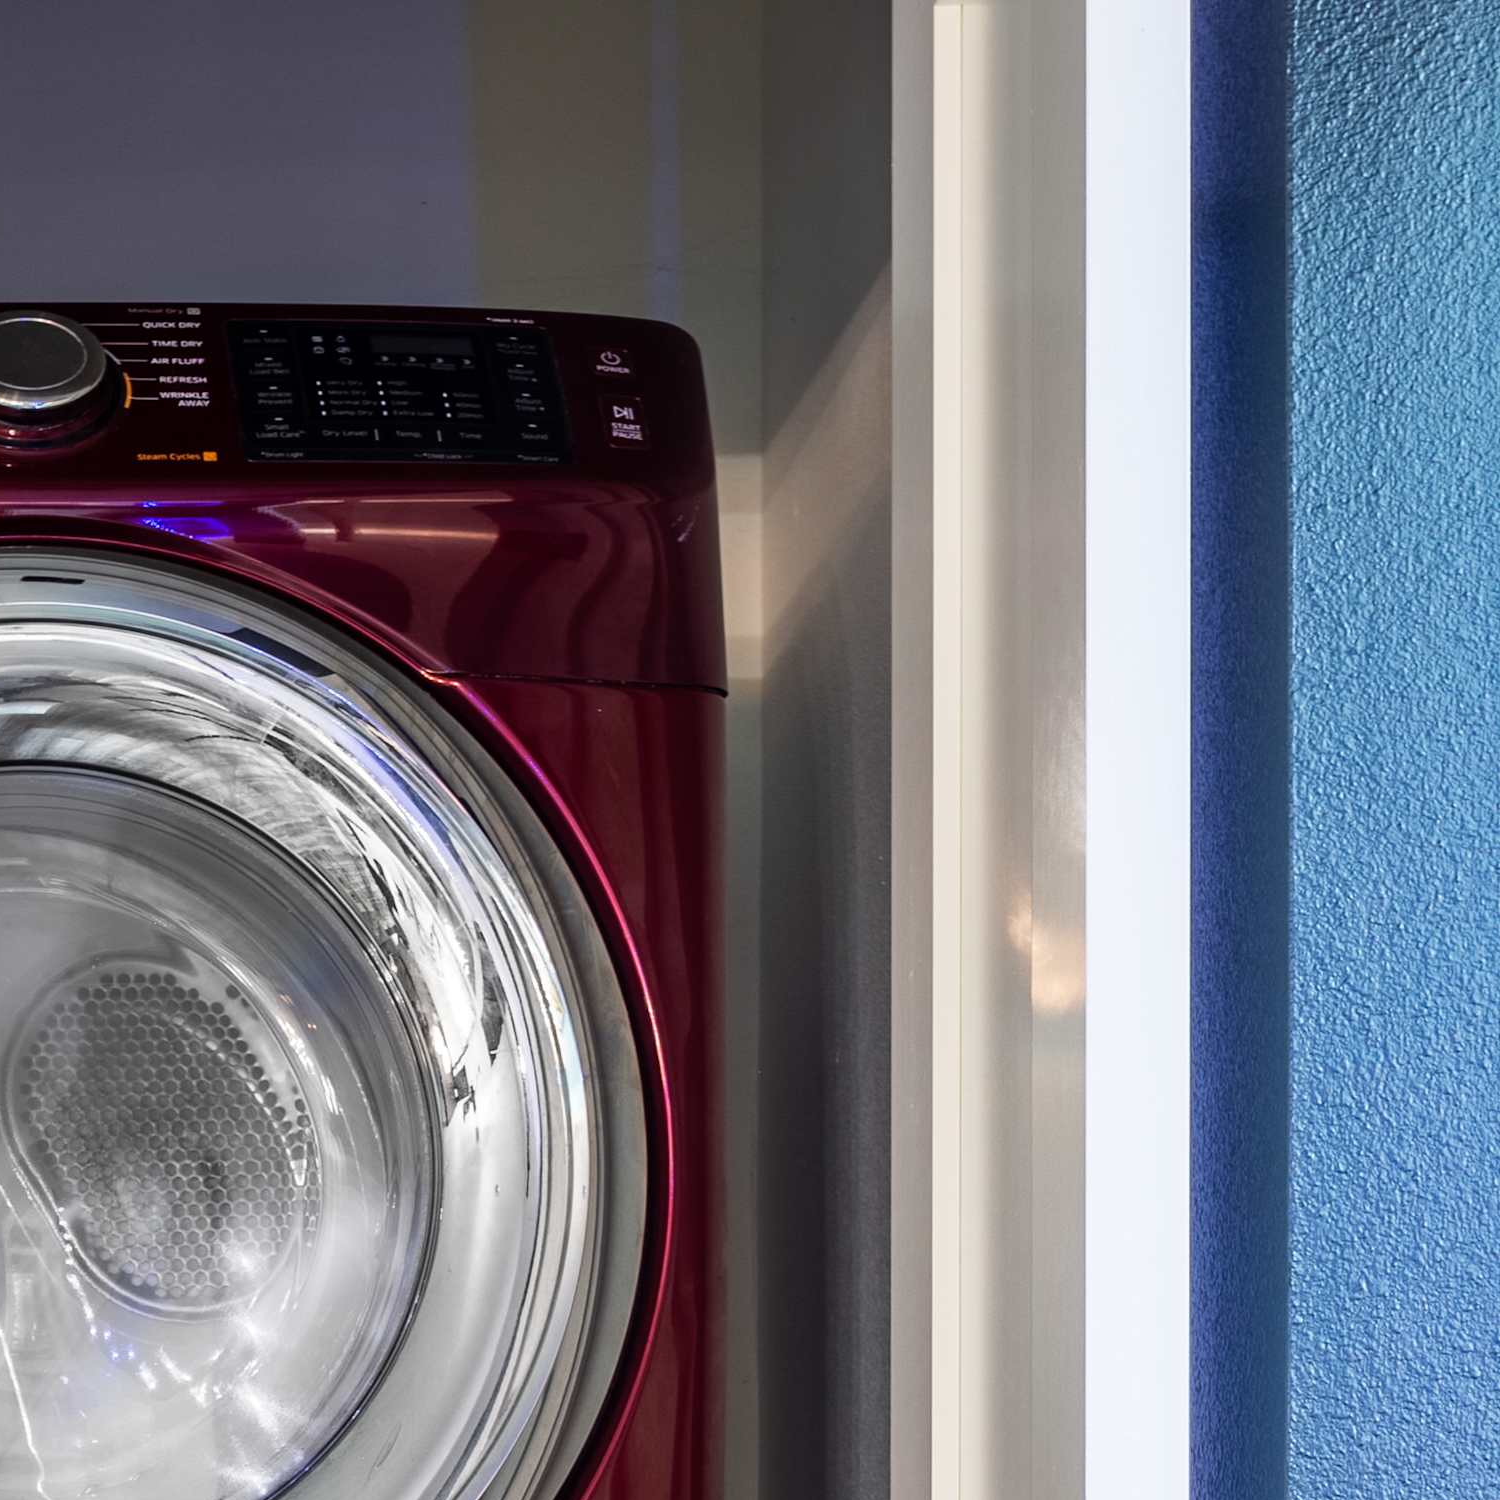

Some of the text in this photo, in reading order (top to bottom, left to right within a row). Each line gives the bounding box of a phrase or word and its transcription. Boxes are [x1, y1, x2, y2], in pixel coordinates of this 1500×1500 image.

[142, 321, 202, 330] QUICK DRY
[151, 340, 204, 348] TIME DRY
[150, 357, 205, 365] AIR FLUFF
[596, 364, 631, 374] POWER
[158, 376, 208, 384] REFRESH
[158, 392, 210, 400] WRINKLE
[177, 399, 211, 407] AWAY
[611, 421, 641, 430] START
[612, 431, 644, 440] PAUSE
[136, 452, 201, 462] Steam Cycles
